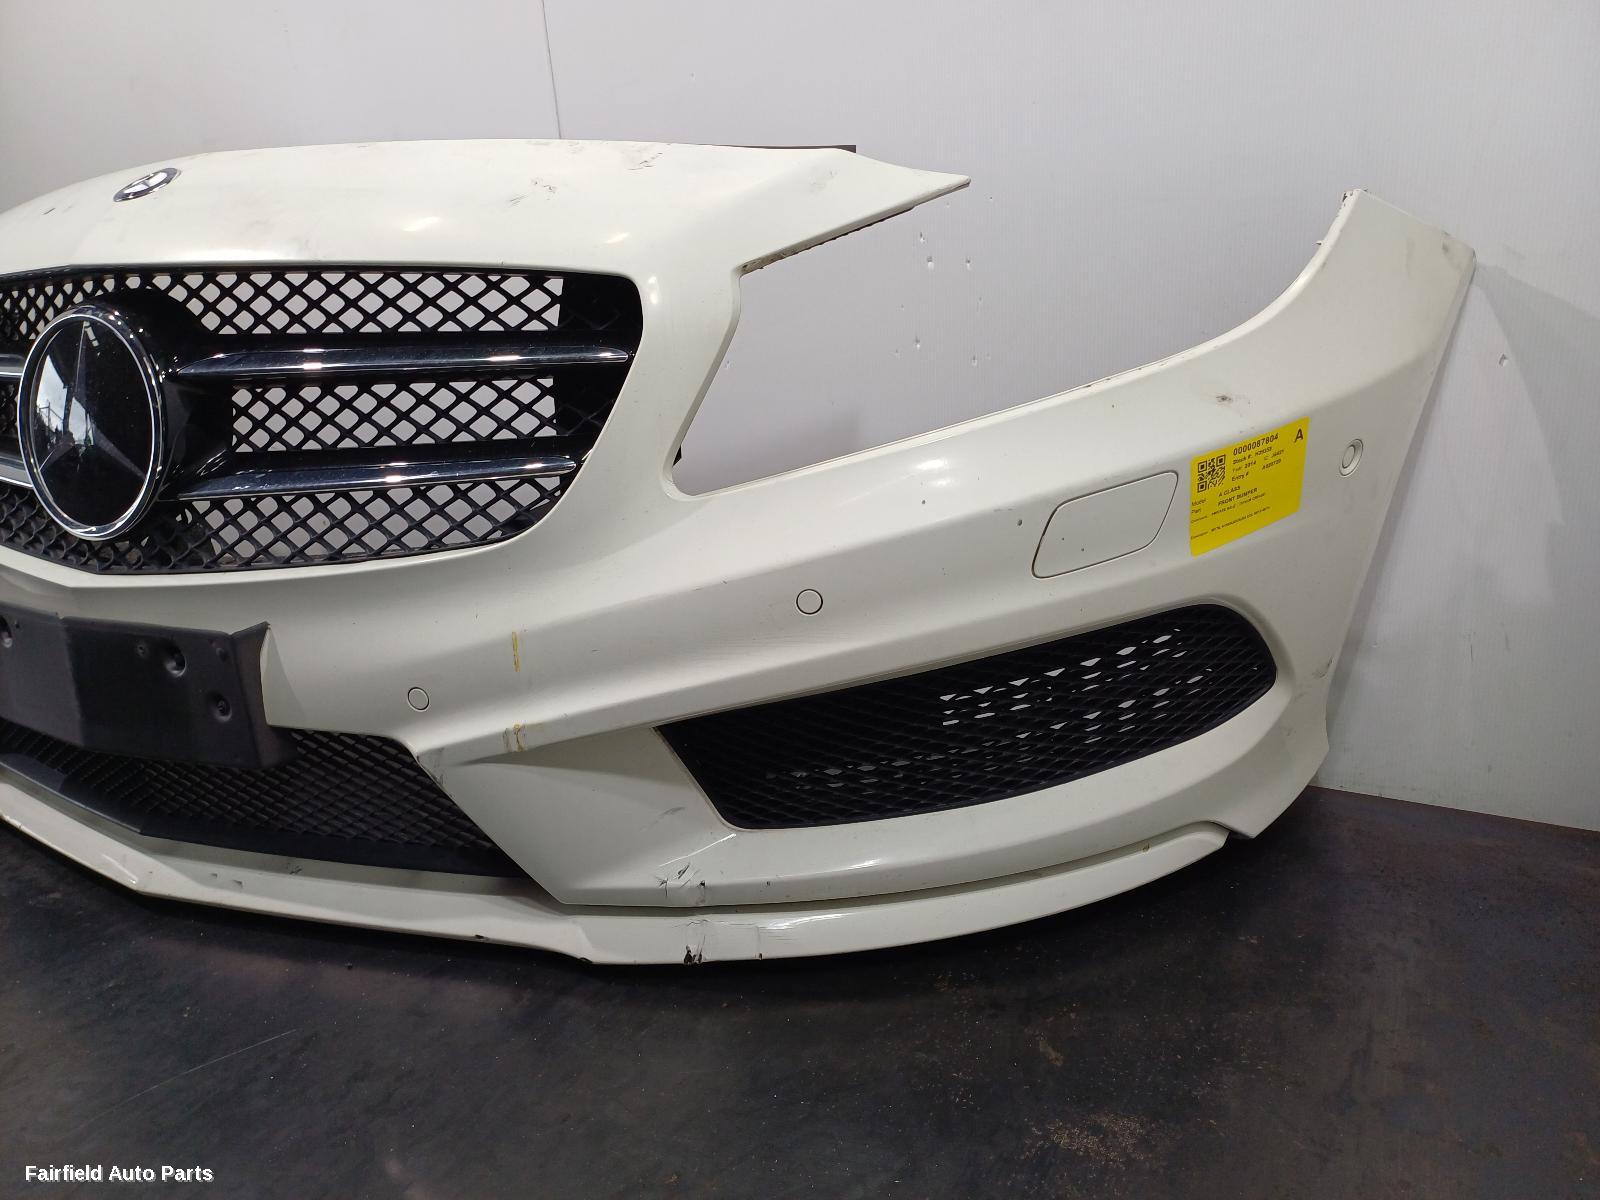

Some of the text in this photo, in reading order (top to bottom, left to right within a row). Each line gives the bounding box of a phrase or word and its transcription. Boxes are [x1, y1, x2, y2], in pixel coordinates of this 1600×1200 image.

[1294, 428, 1304, 443] A
[1217, 495, 1236, 506] FRONT
[1236, 487, 1258, 499] BUMPER
